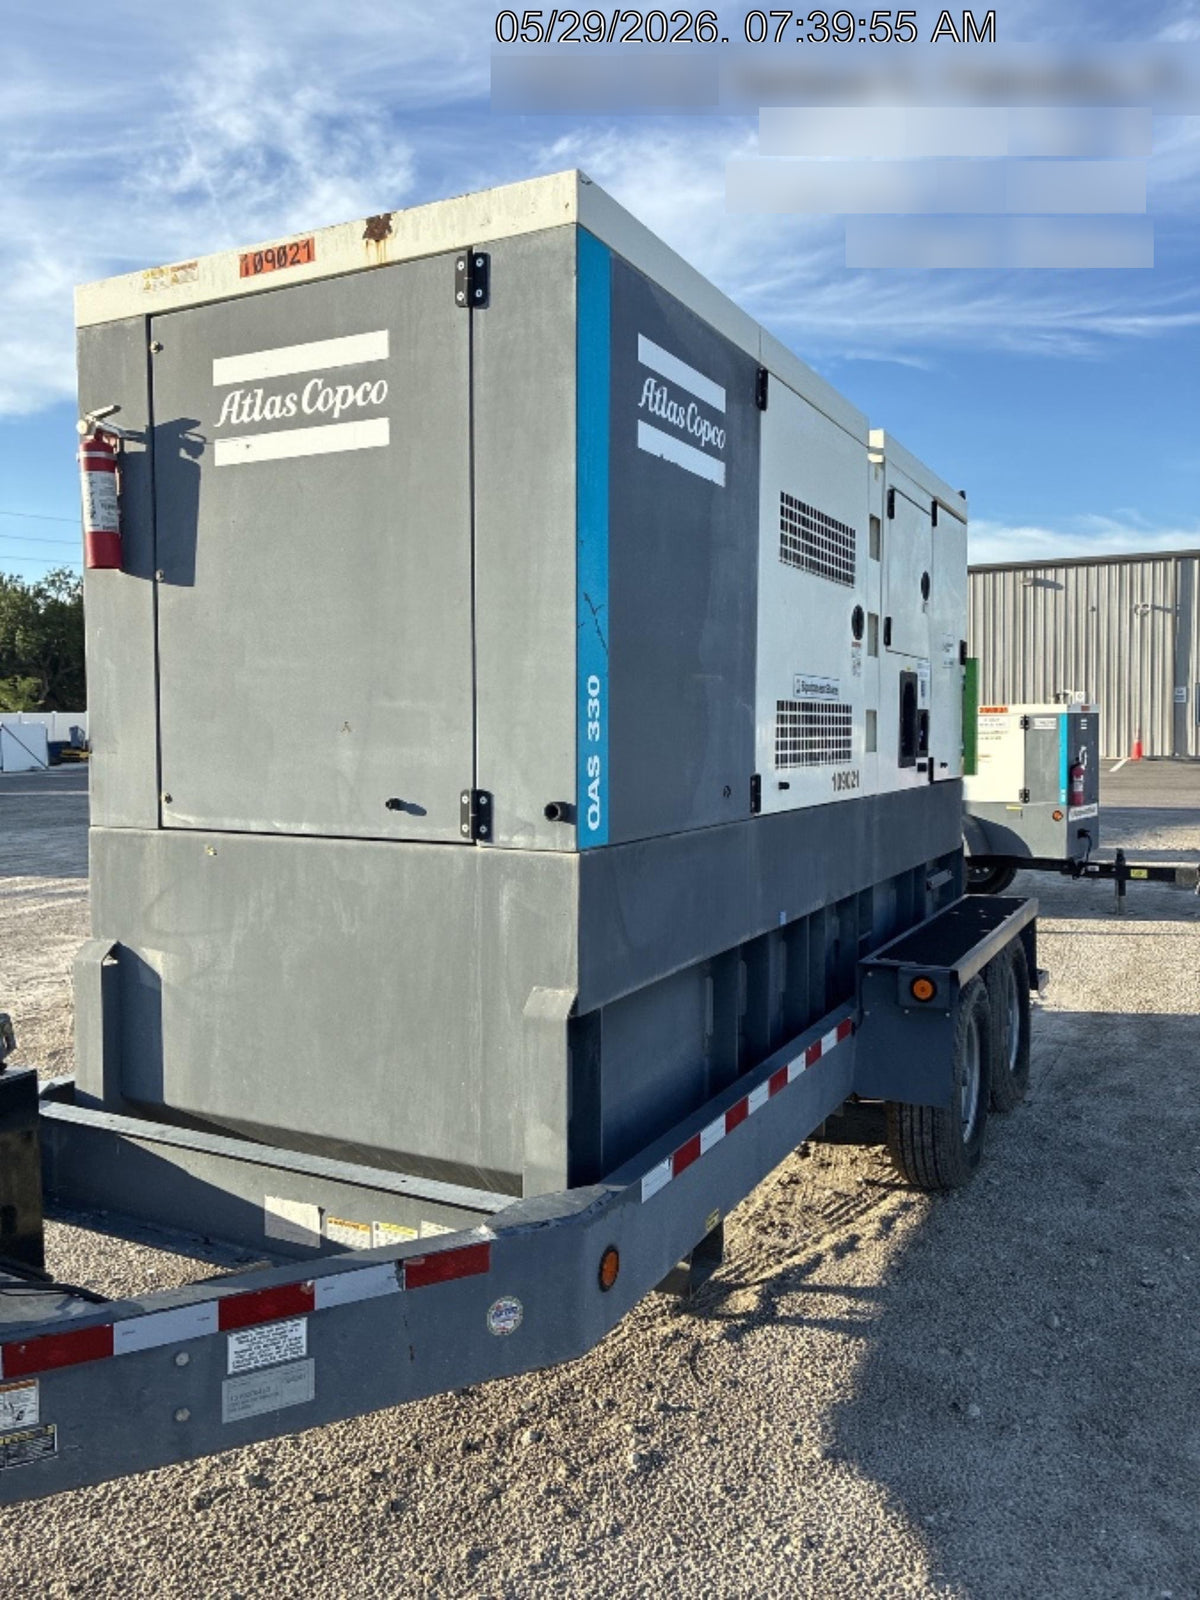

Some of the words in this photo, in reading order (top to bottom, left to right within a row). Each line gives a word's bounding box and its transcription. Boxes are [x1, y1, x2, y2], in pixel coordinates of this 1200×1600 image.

[240, 240, 310, 276] 109021
[214, 388, 298, 427] Atlas
[301, 378, 388, 418] Copco
[638, 377, 686, 429] Atlas
[686, 402, 726, 449] Copco
[587, 674, 600, 742] 330
